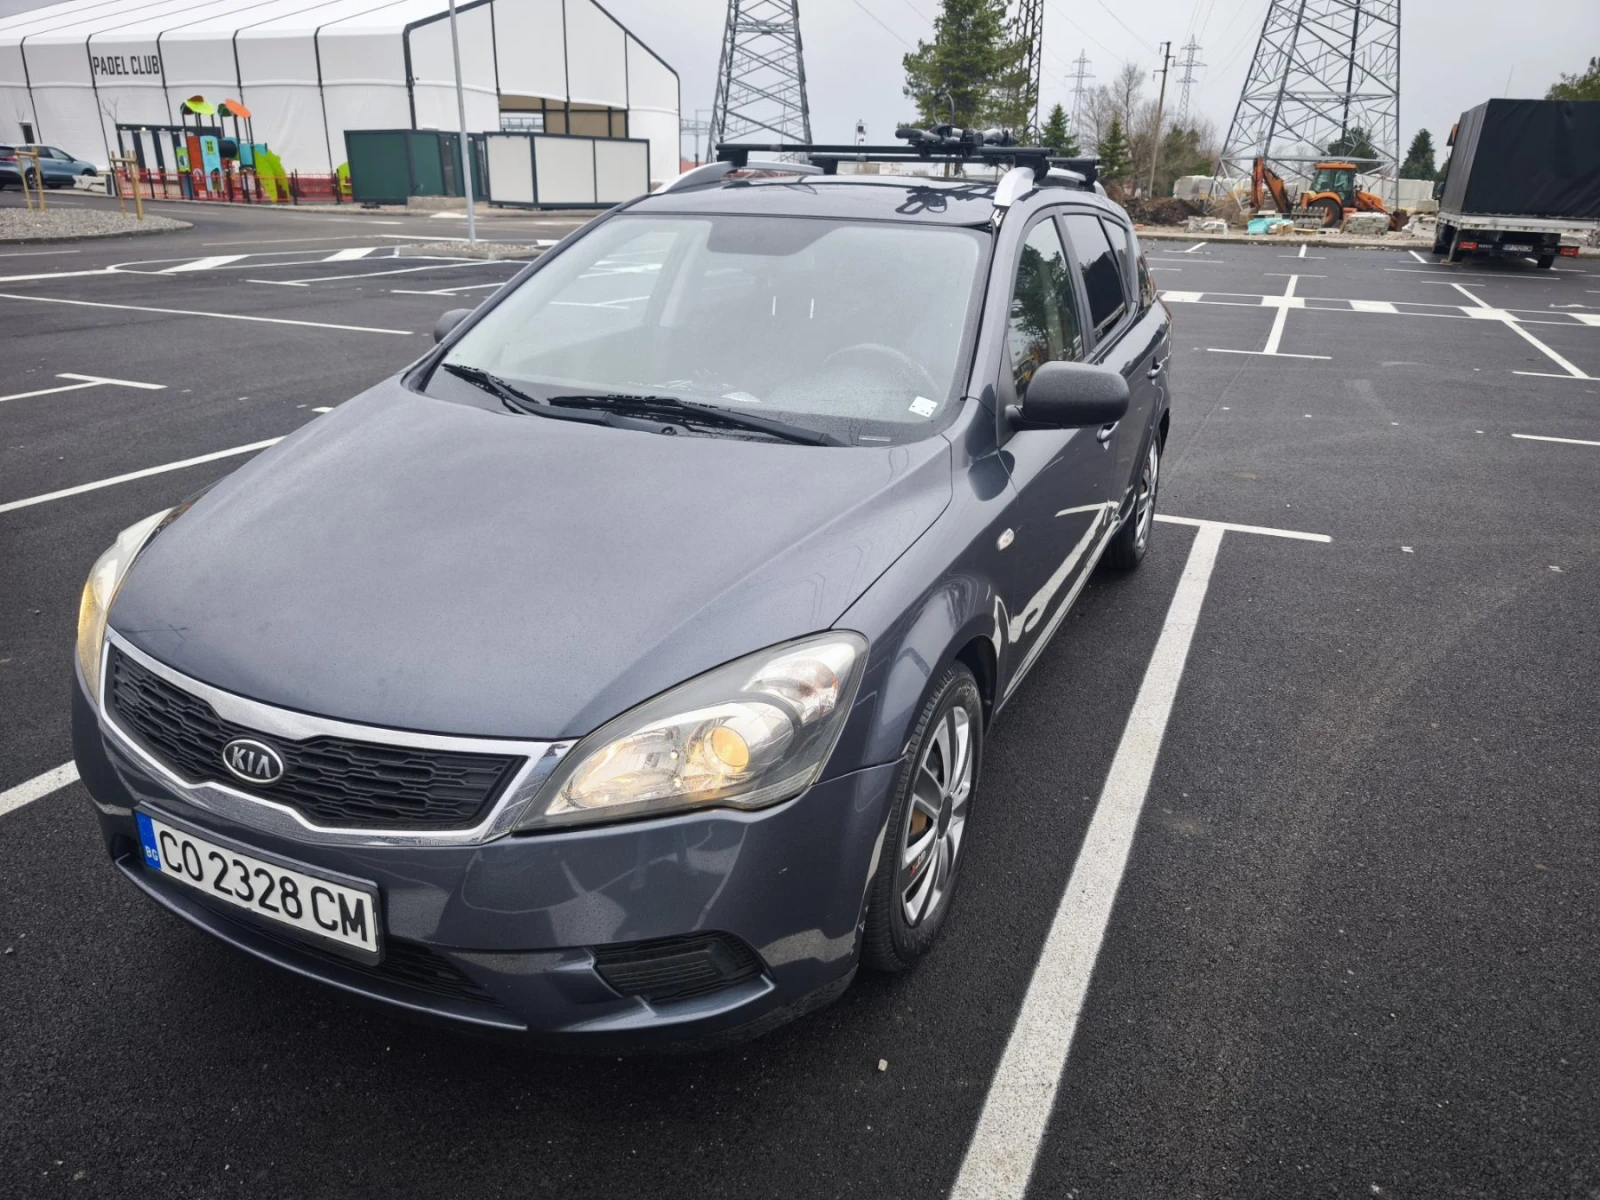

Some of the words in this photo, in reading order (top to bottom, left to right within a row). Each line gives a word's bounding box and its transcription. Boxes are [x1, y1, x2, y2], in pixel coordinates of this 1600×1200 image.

[92, 56, 129, 75] PADEL
[130, 55, 160, 75] CLUB
[232, 746, 271, 778] KIA
[145, 845, 158, 861] BG
[159, 830, 204, 882] CO
[208, 850, 303, 919] 2328
[310, 885, 368, 942] CM
